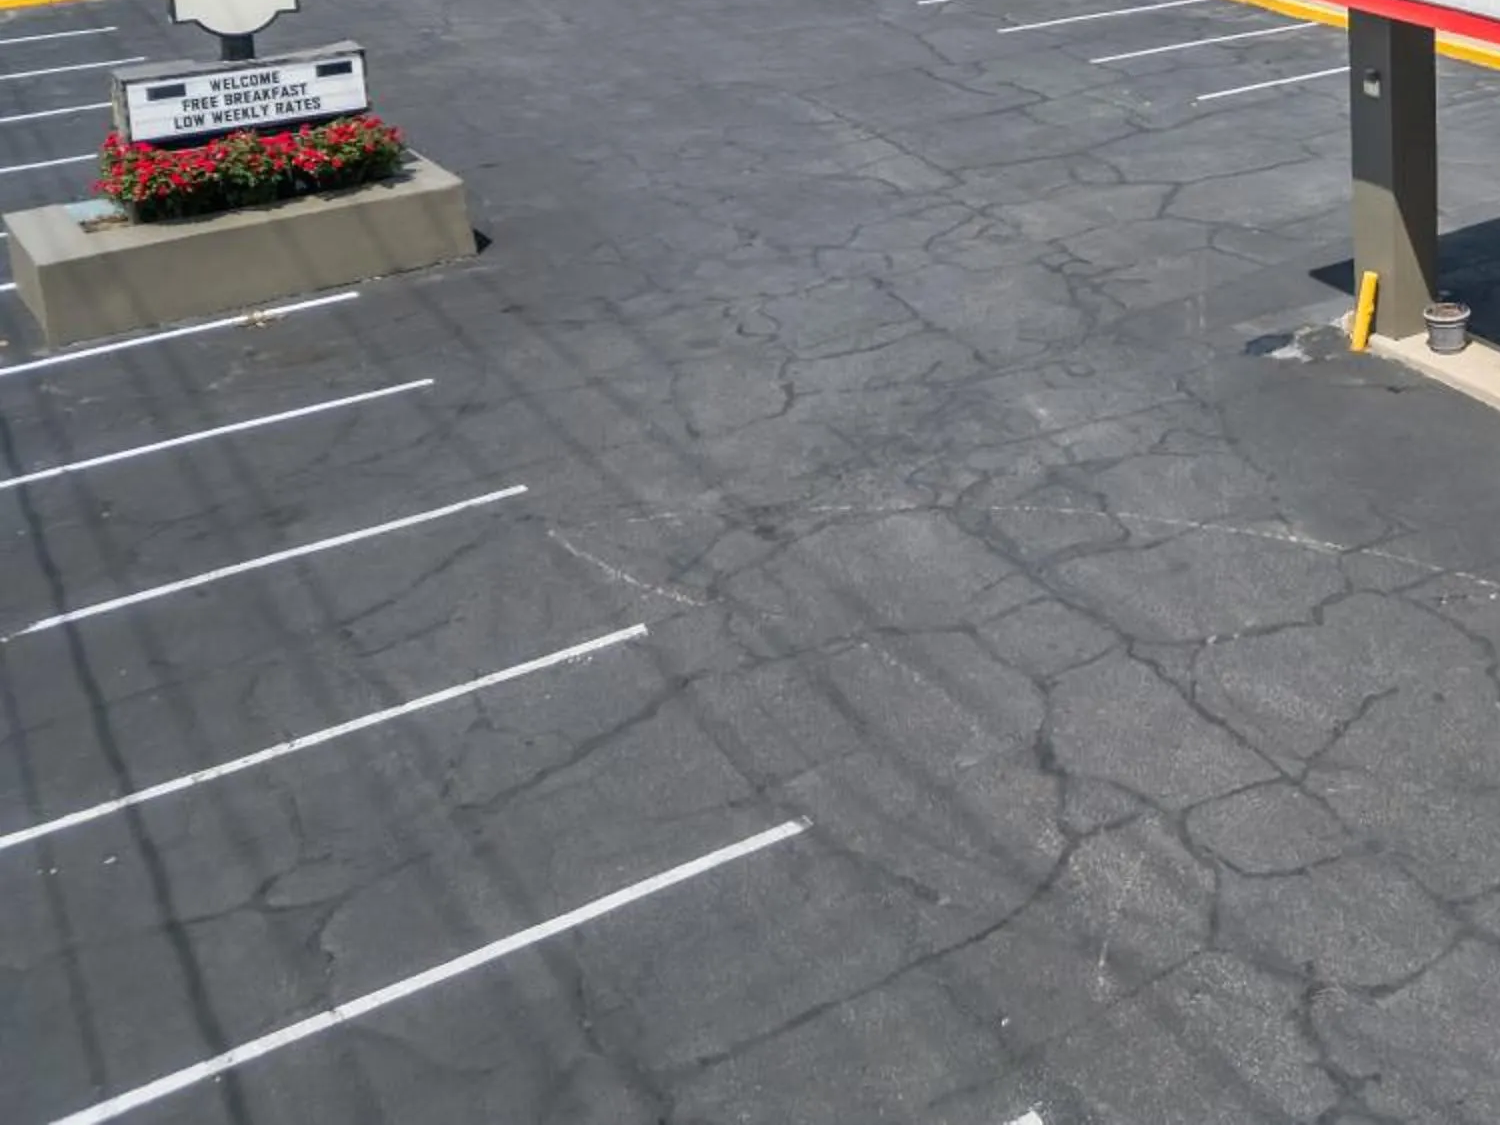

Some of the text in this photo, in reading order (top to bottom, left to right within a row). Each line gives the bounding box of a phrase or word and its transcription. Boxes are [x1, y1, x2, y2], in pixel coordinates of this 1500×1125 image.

[209, 70, 281, 92] WELCOME
[181, 82, 308, 112] FREE BREAKFAST
[173, 96, 322, 130] LOW WEEKLY RATES
